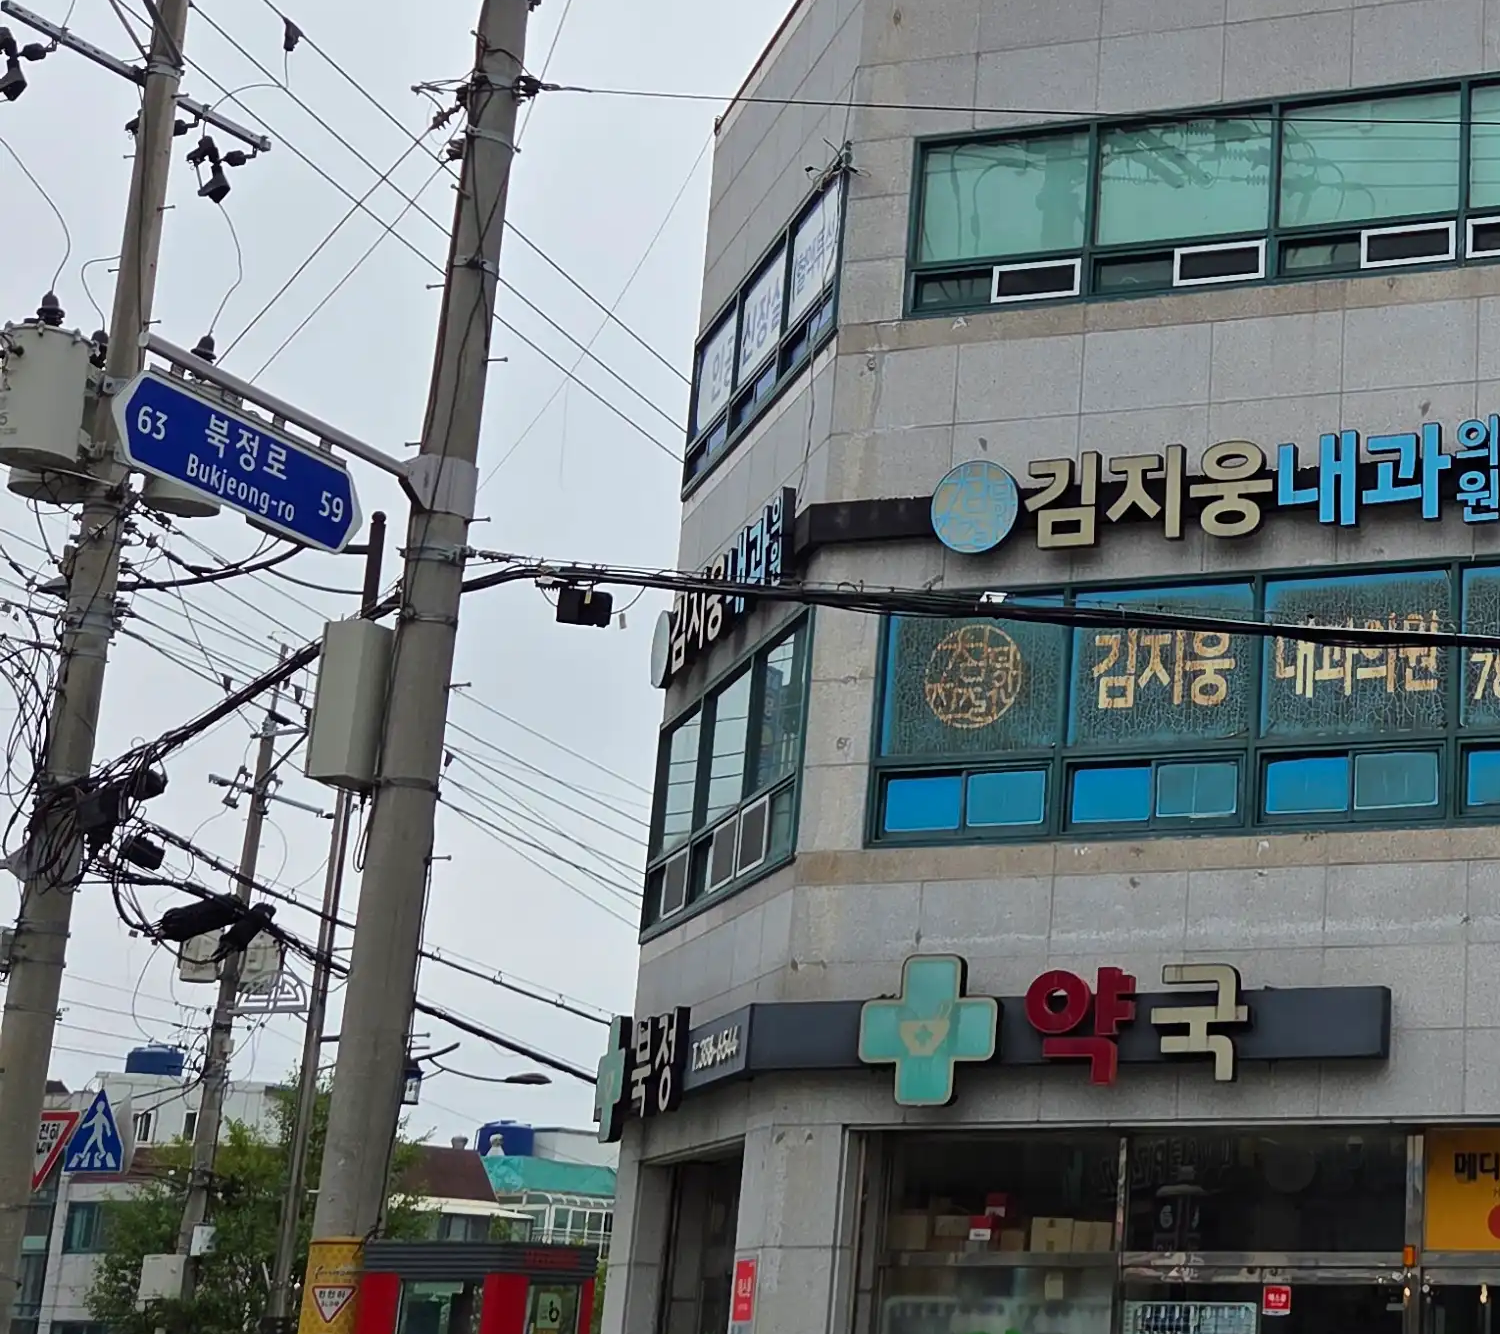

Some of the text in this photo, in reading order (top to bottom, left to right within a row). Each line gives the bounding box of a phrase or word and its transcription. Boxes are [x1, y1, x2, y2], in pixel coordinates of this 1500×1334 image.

[135, 404, 168, 442] 63
[204, 413, 288, 481] 북정로
[186, 452, 296, 523] Bukjeong-ro
[318, 489, 345, 525] 59
[1092, 627, 1236, 711] 김지웅
[1025, 962, 1249, 1087] 약국
[631, 1007, 679, 1118] 북정
[1454, 1151, 1500, 1182] 메디
